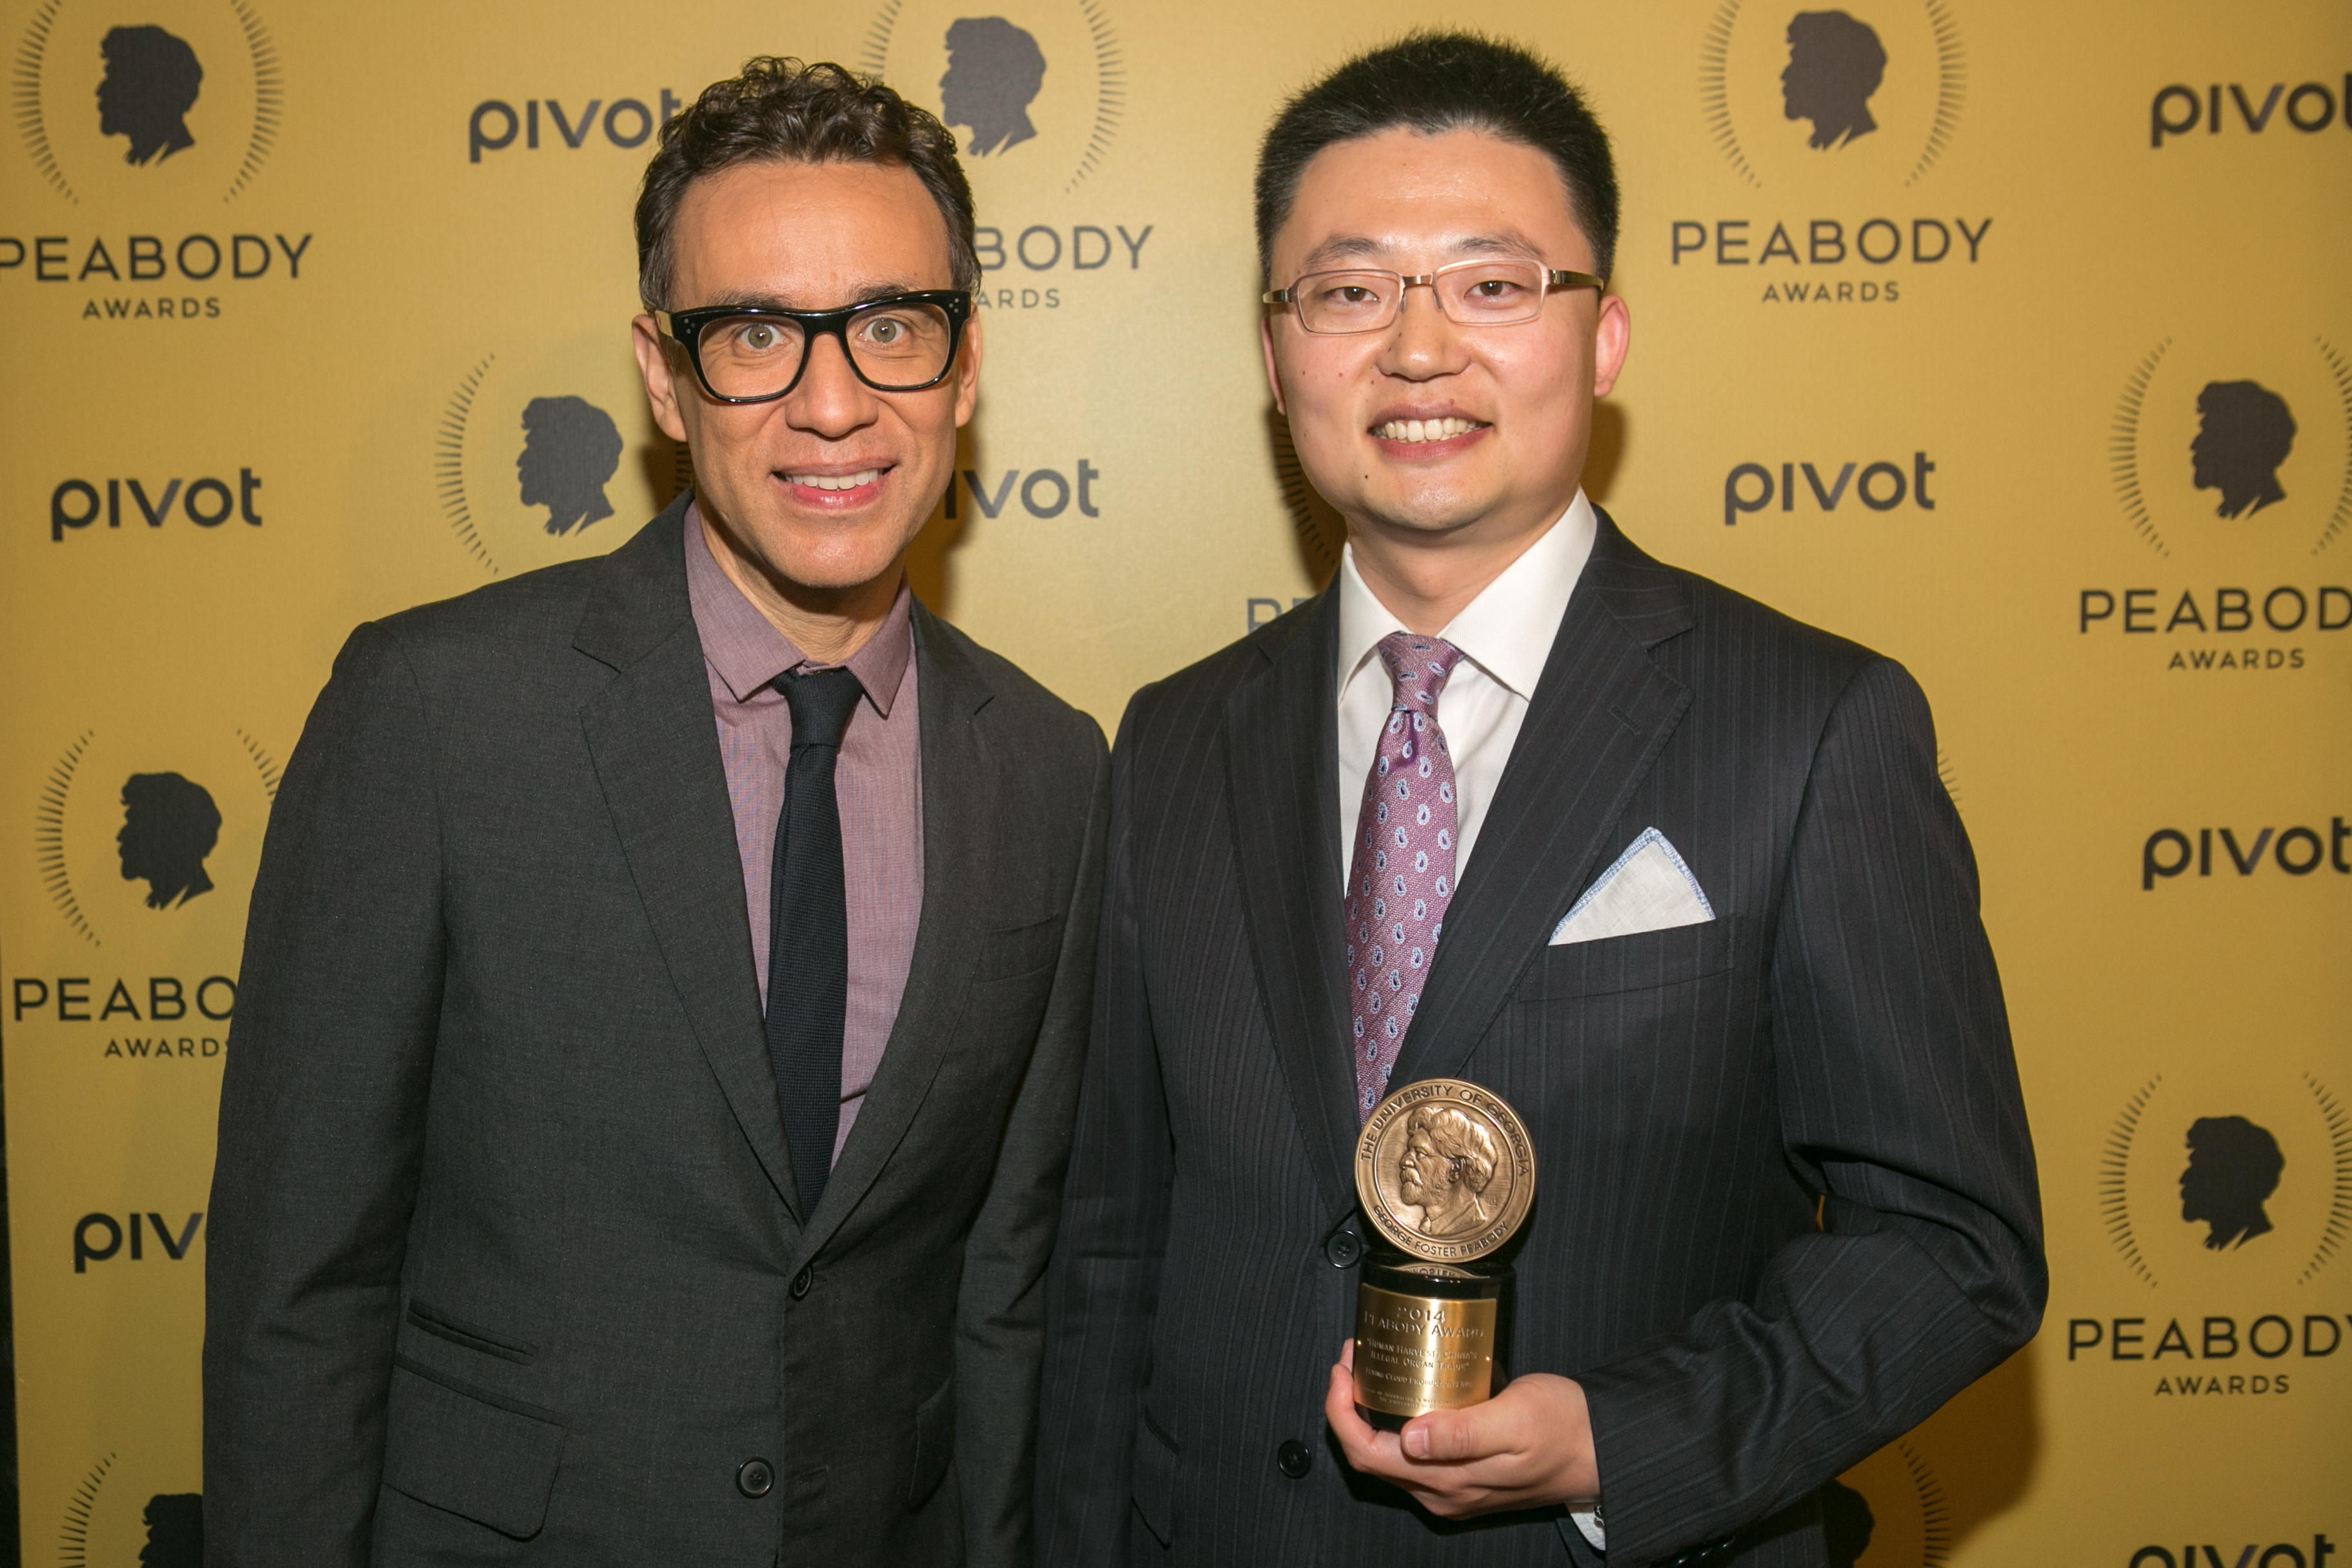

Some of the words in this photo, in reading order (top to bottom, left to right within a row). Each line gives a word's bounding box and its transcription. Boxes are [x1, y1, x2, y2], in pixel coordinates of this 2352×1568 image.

[0, 234, 312, 282] PEABODY
[1671, 218, 1991, 265] PEABODY
[82, 297, 220, 319] AWARDS
[1762, 281, 1898, 303] AWARDS
[50, 468, 262, 542] pivot
[1724, 452, 1935, 527] pivot
[2167, 648, 2304, 670] AWARDS
[2142, 817, 2352, 891] pivot
[105, 1038, 228, 1058] AWARD
[1361, 1132, 1377, 1161] THE
[1372, 1085, 1453, 1131] UNIVERSITY
[1460, 1090, 1482, 1103] OF
[1486, 1102, 1529, 1176] GEORGIA
[74, 1212, 205, 1274] piv
[1374, 1205, 1412, 1245] GEORGE
[1414, 1241, 1456, 1256] FOSTER
[1460, 1221, 1509, 1256] PEABODY
[1397, 1307, 1445, 1323] 2014
[2068, 1315, 2352, 1361] PEABOD
[2155, 1375, 2289, 1395] AWARDS
